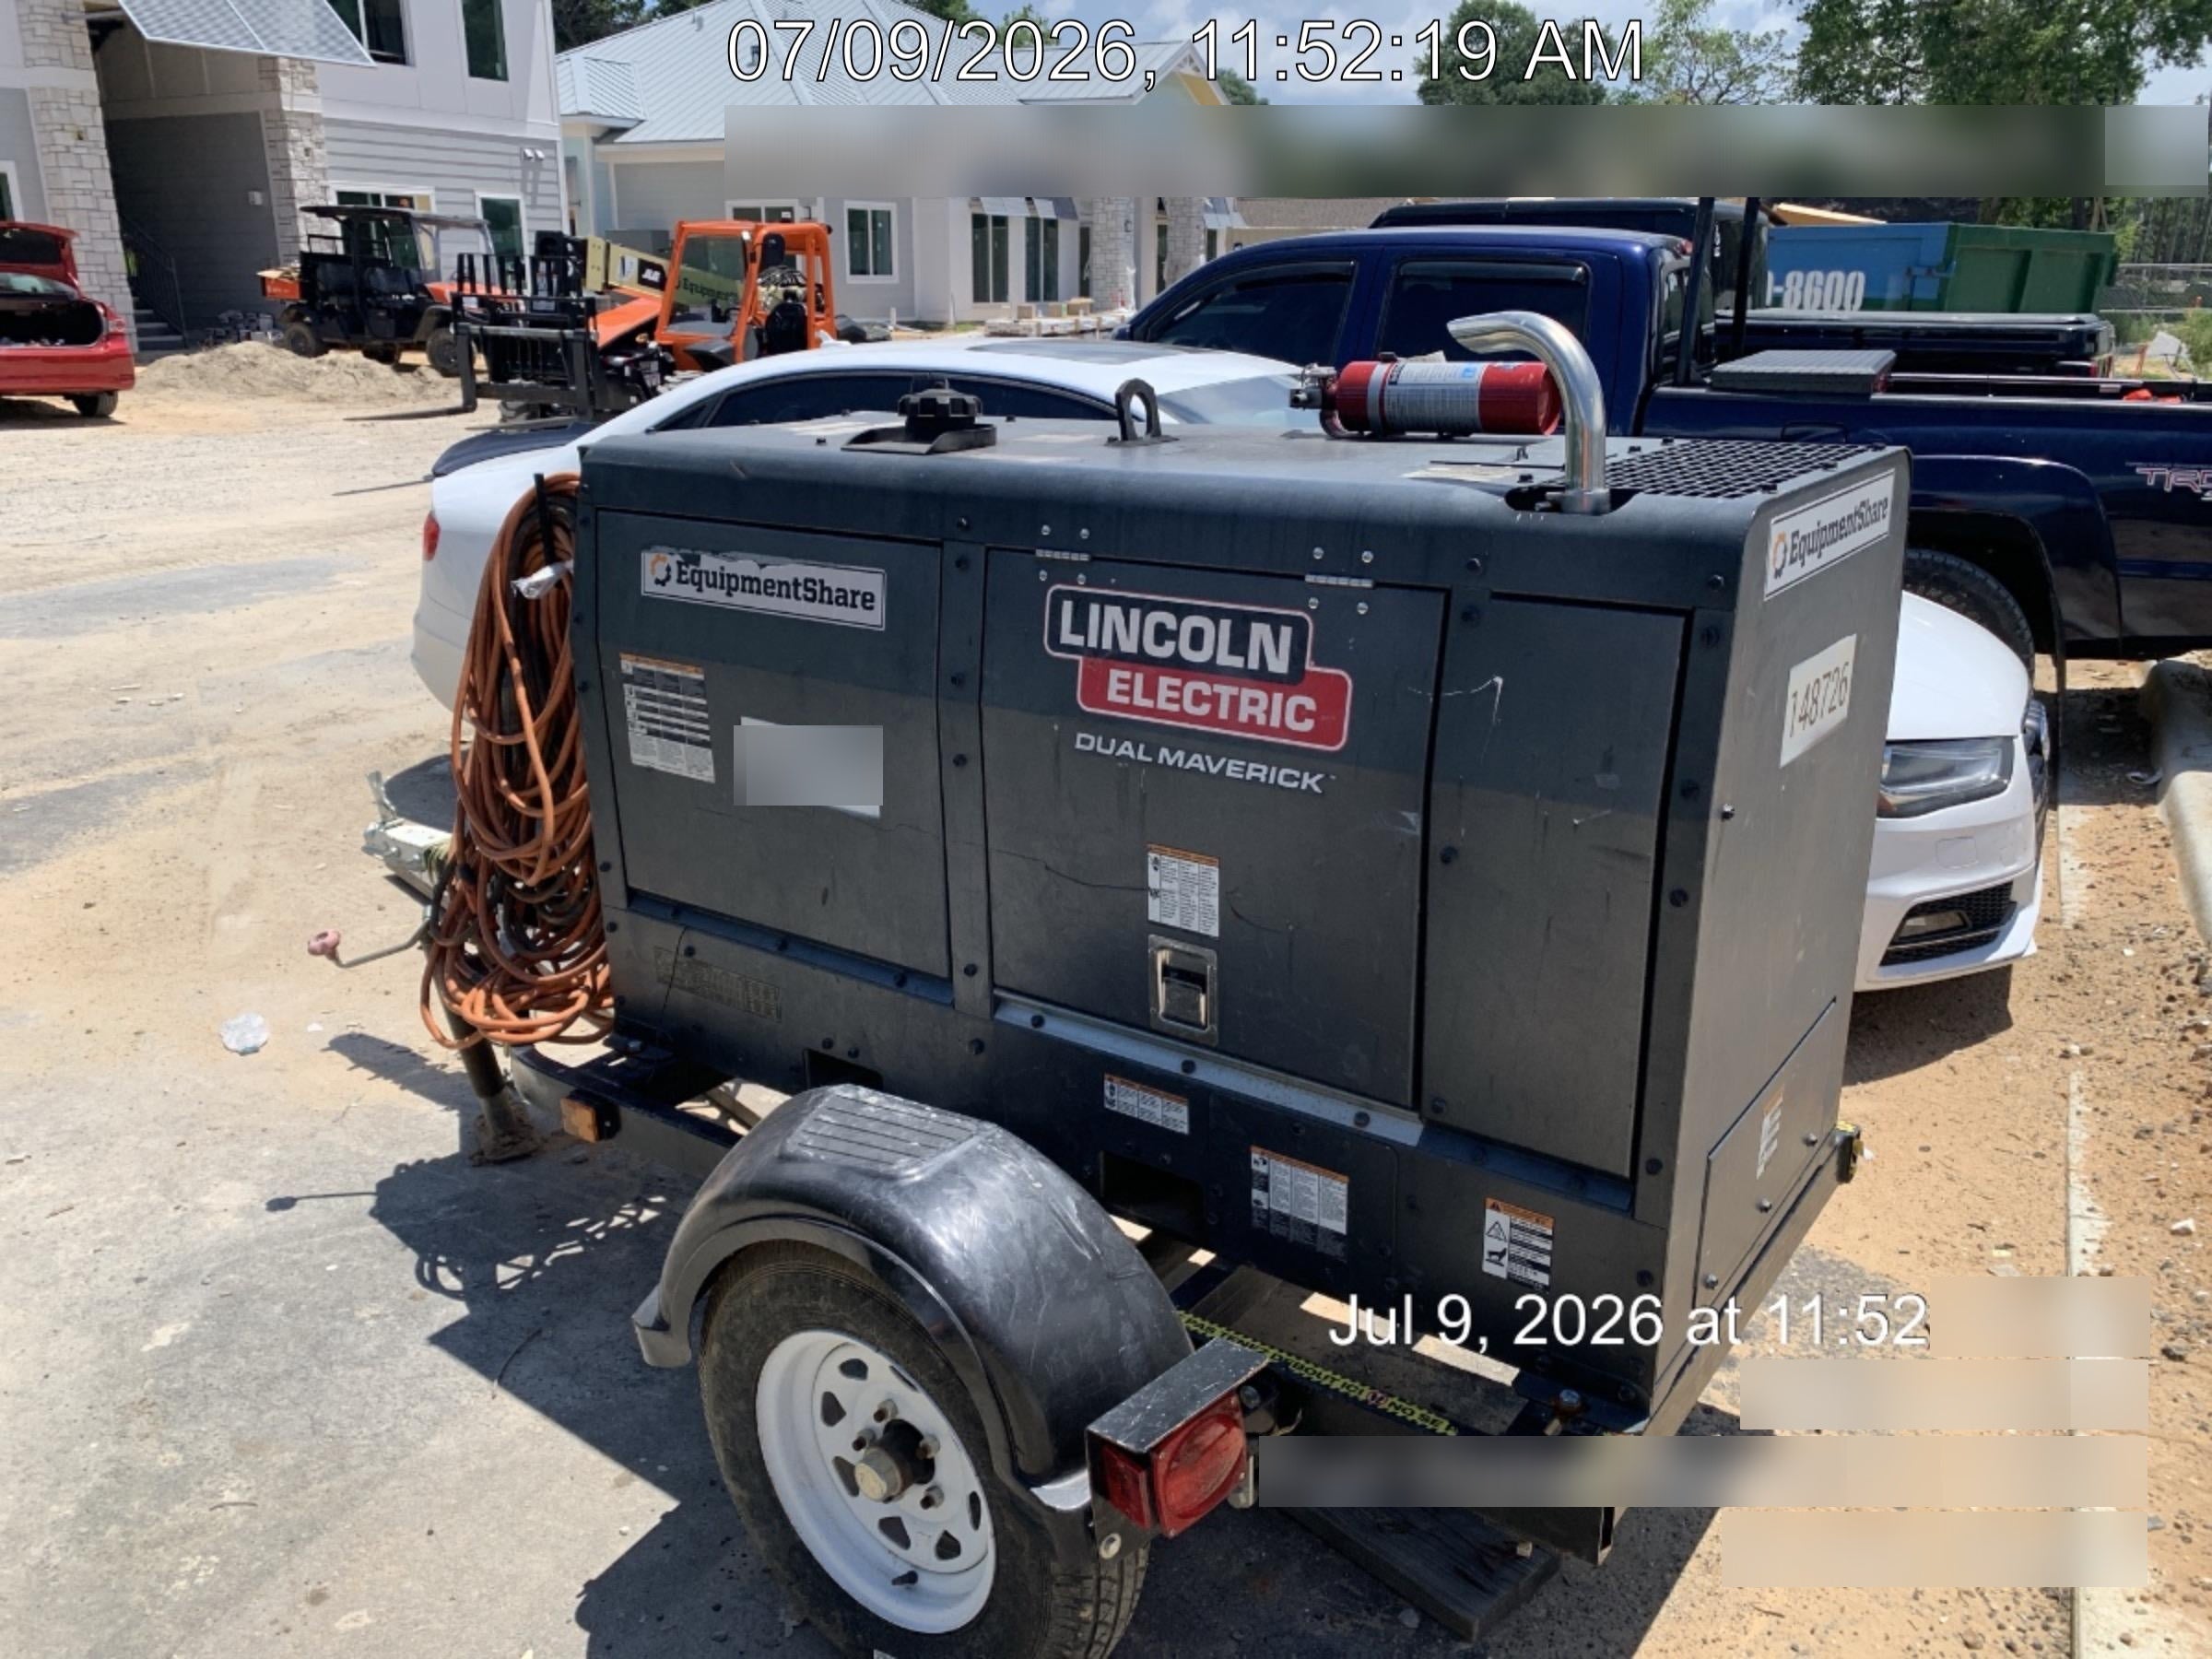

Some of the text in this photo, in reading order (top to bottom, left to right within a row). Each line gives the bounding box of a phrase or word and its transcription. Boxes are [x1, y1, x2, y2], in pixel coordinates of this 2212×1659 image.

[1788, 497, 1888, 569] EquipmentShare
[676, 559, 876, 612] EquipmentShare
[1059, 599, 1293, 675] LINCOLN
[1107, 667, 1318, 732] ELECTRIC
[1789, 661, 1850, 738] 148726
[1074, 732, 1324, 794] DUAL MAVERICK
